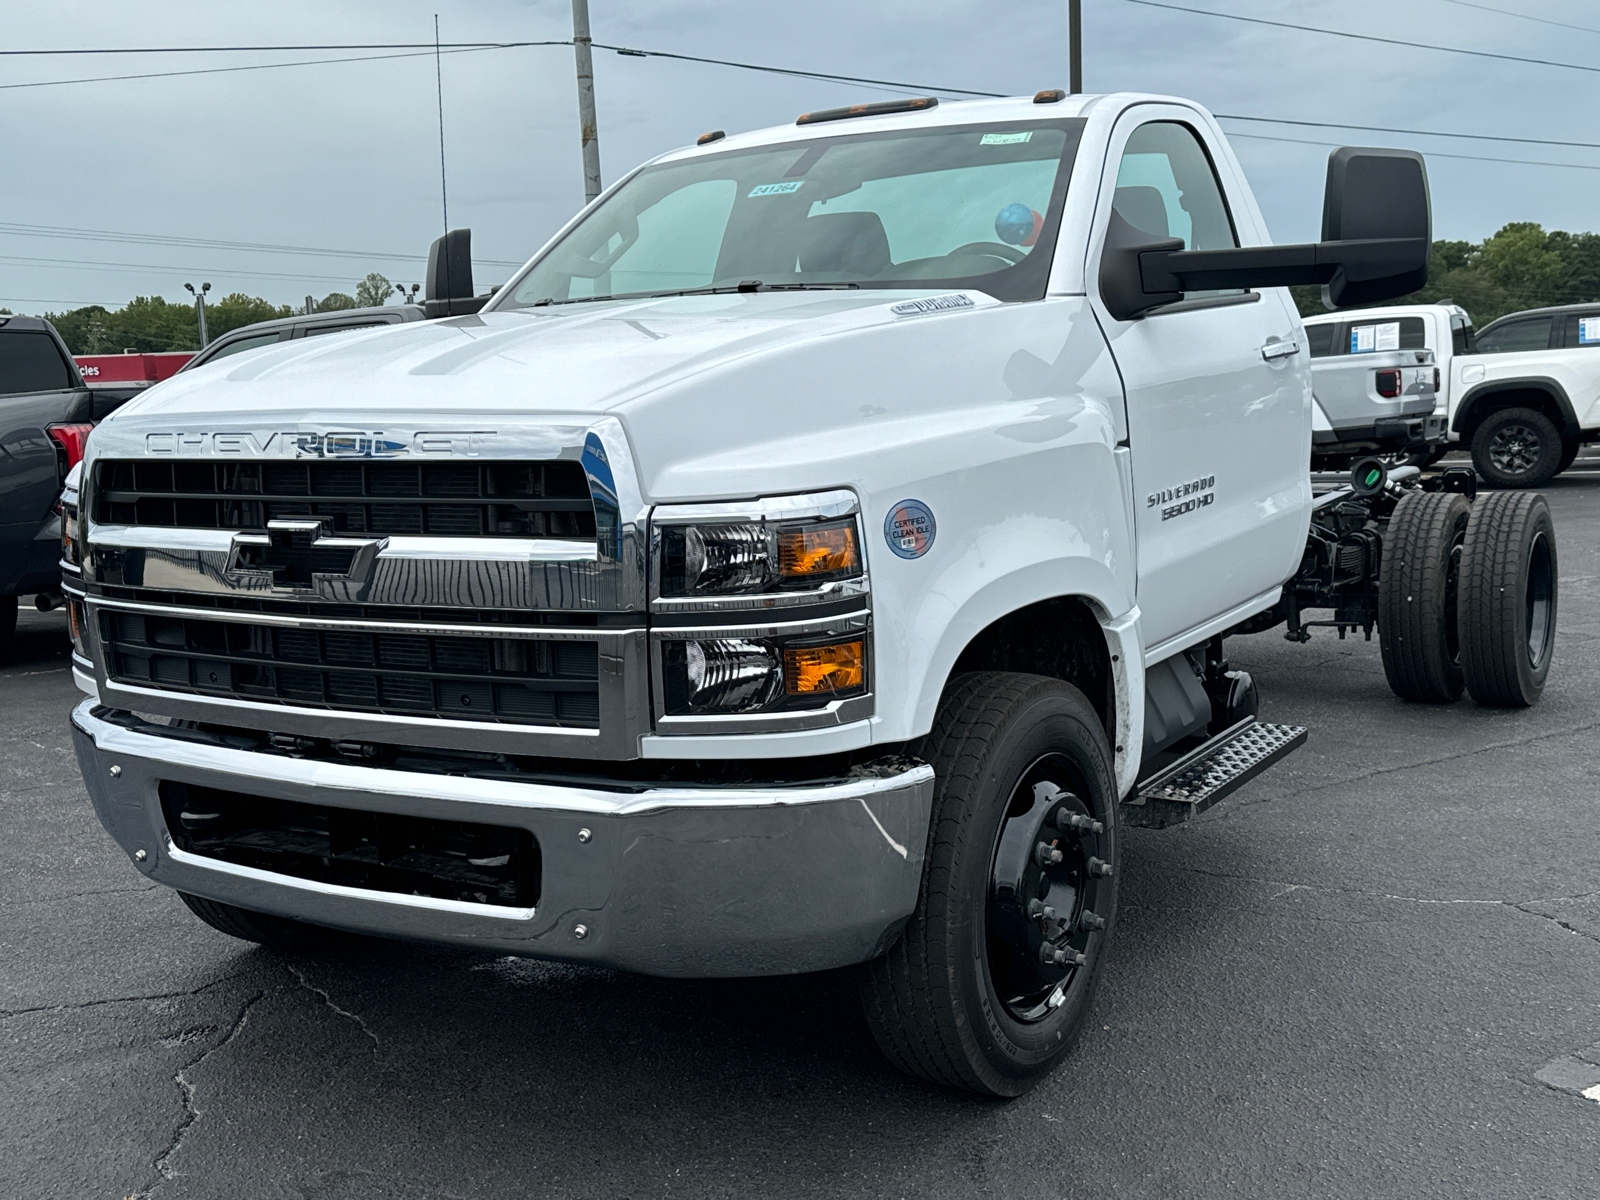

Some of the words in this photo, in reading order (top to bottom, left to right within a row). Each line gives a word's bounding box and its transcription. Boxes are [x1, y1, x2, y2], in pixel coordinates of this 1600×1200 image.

[752, 182, 798, 195] 241264
[77, 365, 100, 376] cles
[145, 431, 498, 456] CHEVROLET
[1146, 475, 1215, 508] SILVERADO
[1161, 498, 1196, 521] 5500
[1196, 492, 1214, 509] HD
[894, 516, 926, 529] CERTIFIED
[892, 528, 915, 539] CLEAN
[916, 525, 930, 535] IDLE
